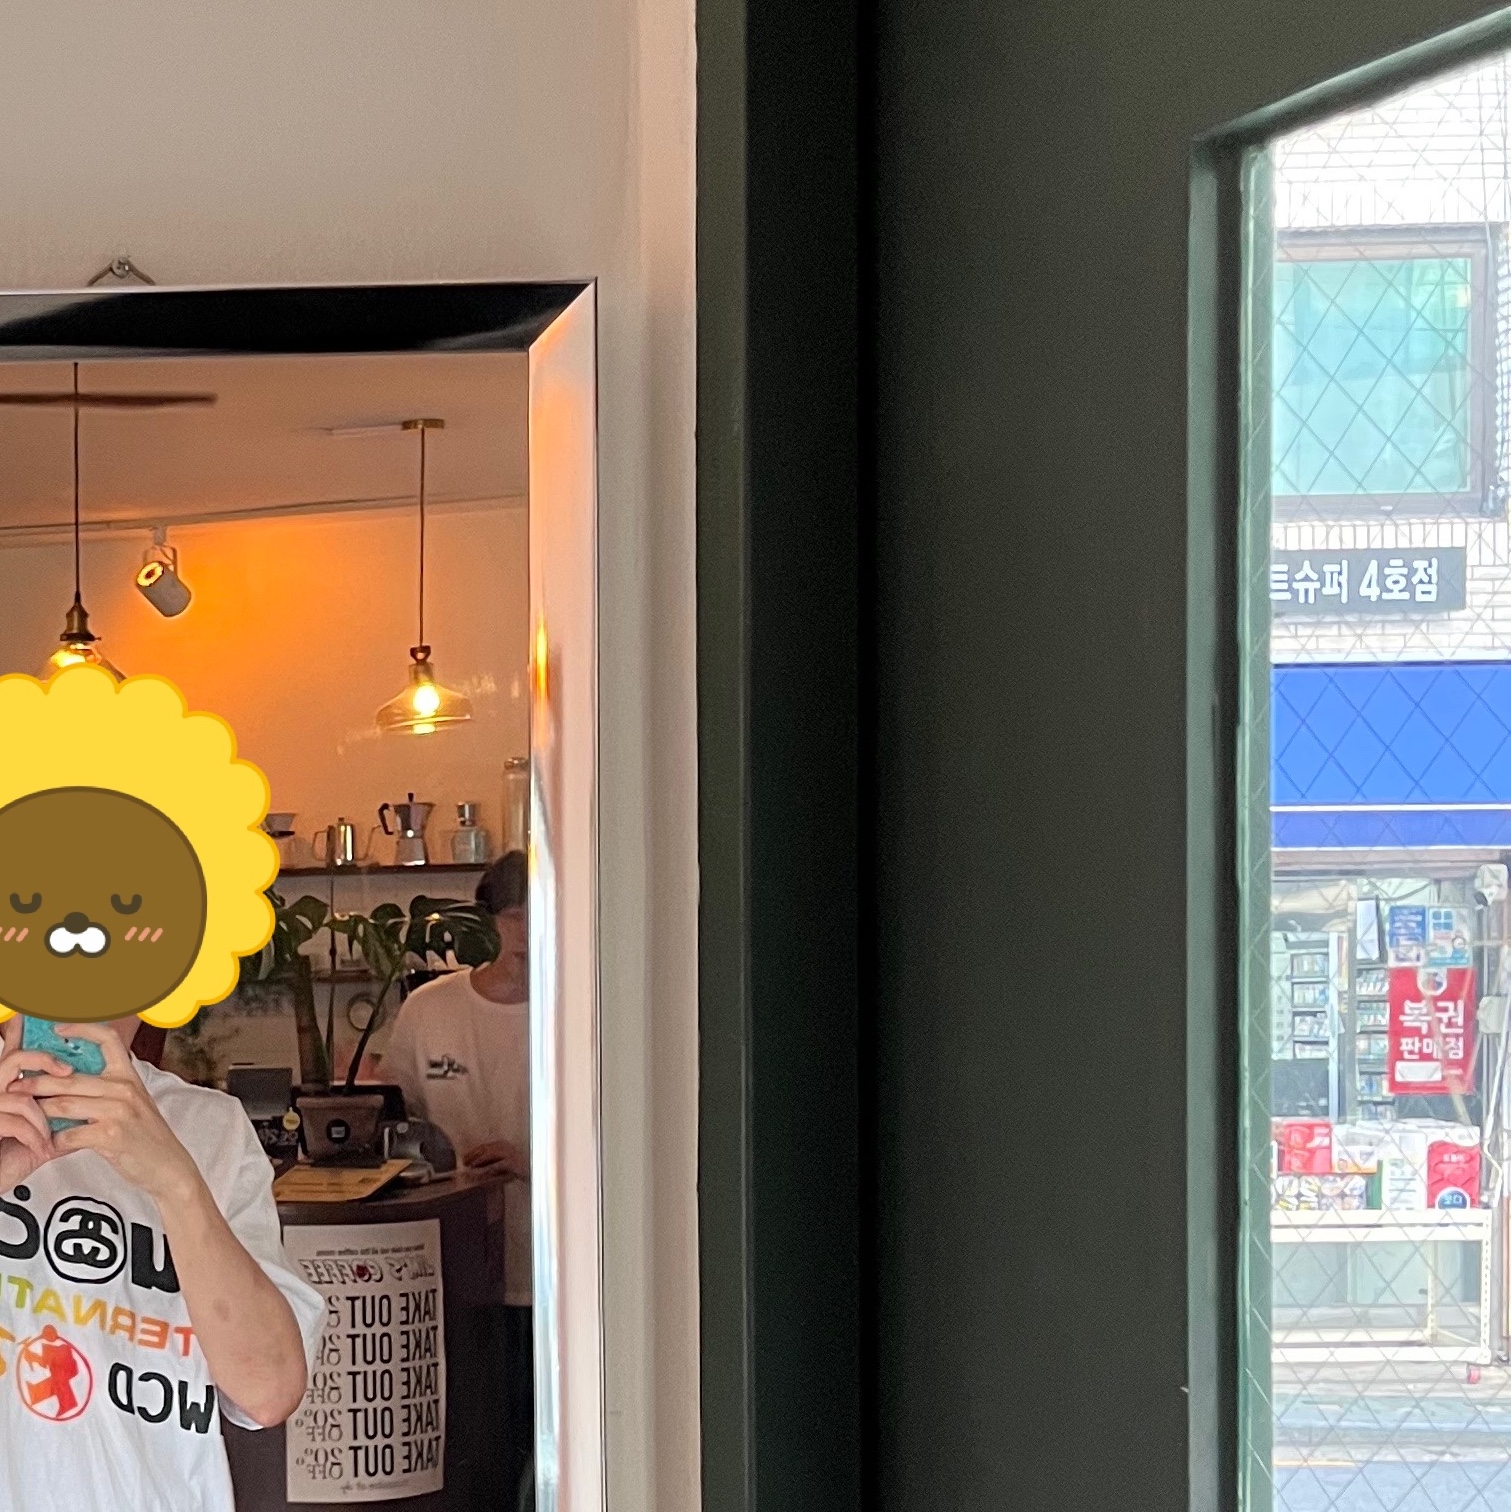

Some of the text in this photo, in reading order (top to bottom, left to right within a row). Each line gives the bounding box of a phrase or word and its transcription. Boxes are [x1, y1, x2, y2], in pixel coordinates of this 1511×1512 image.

[1359, 556, 1439, 603] 4호점
[1399, 999, 1465, 1034] 복권
[1399, 1038, 1464, 1060] 판매점
